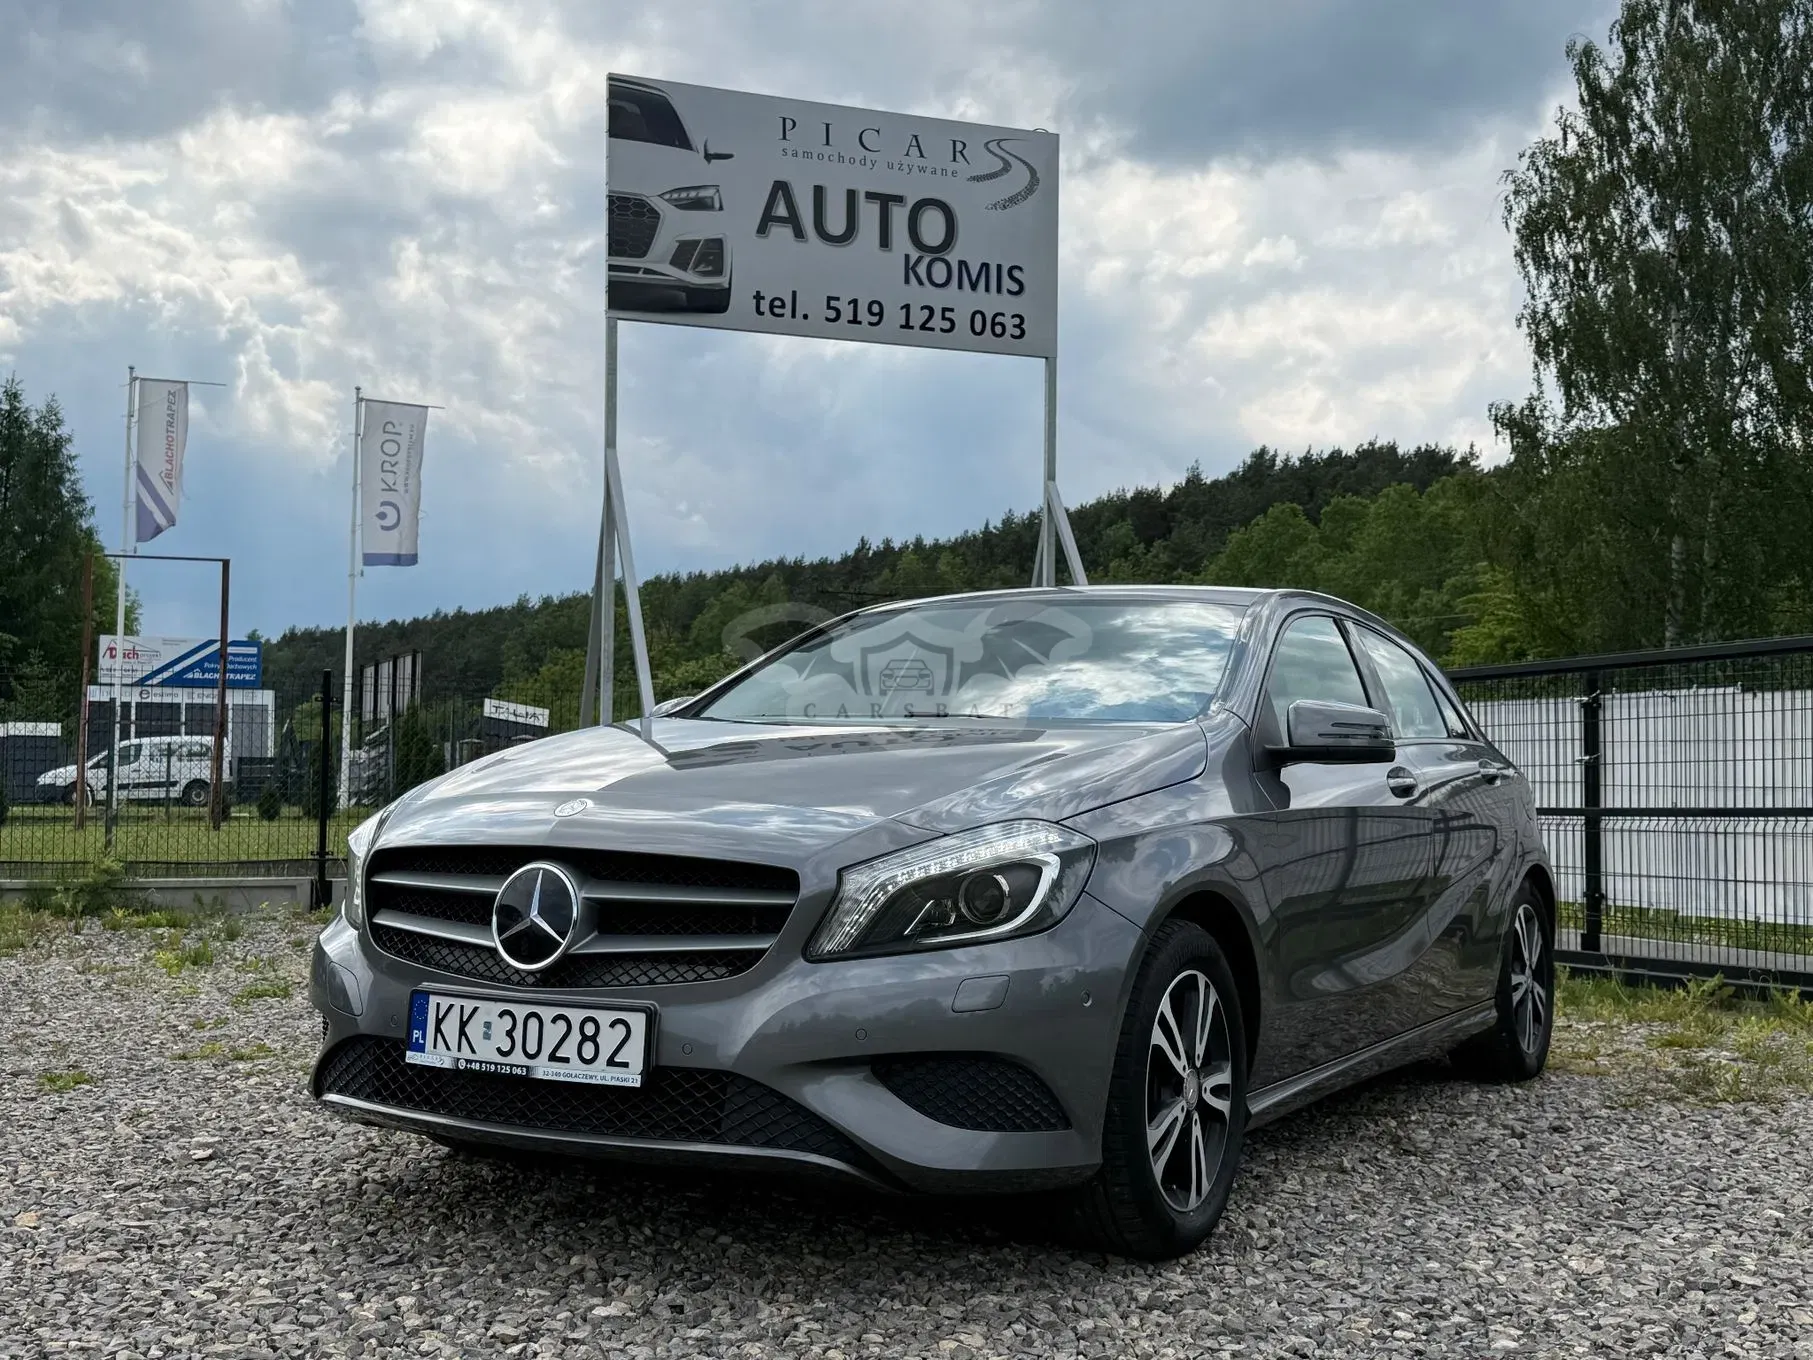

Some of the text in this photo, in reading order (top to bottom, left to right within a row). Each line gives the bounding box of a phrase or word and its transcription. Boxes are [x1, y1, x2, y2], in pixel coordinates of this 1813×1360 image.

[781, 147, 959, 178] samochody używane
[755, 179, 957, 256] AUTO
[903, 252, 1026, 297] KOMIS
[753, 289, 1027, 340] tel. 519 125 063
[163, 390, 177, 480] BLACHOTRAPEZ
[380, 420, 402, 493] KROP
[193, 672, 257, 681] BLACHTRAPEZ
[413, 1031, 424, 1044] PL
[433, 1002, 632, 1069] KK 30282
[466, 1061, 527, 1076] +48 519 125 063
[610, 1075, 630, 1084] PIASKI
